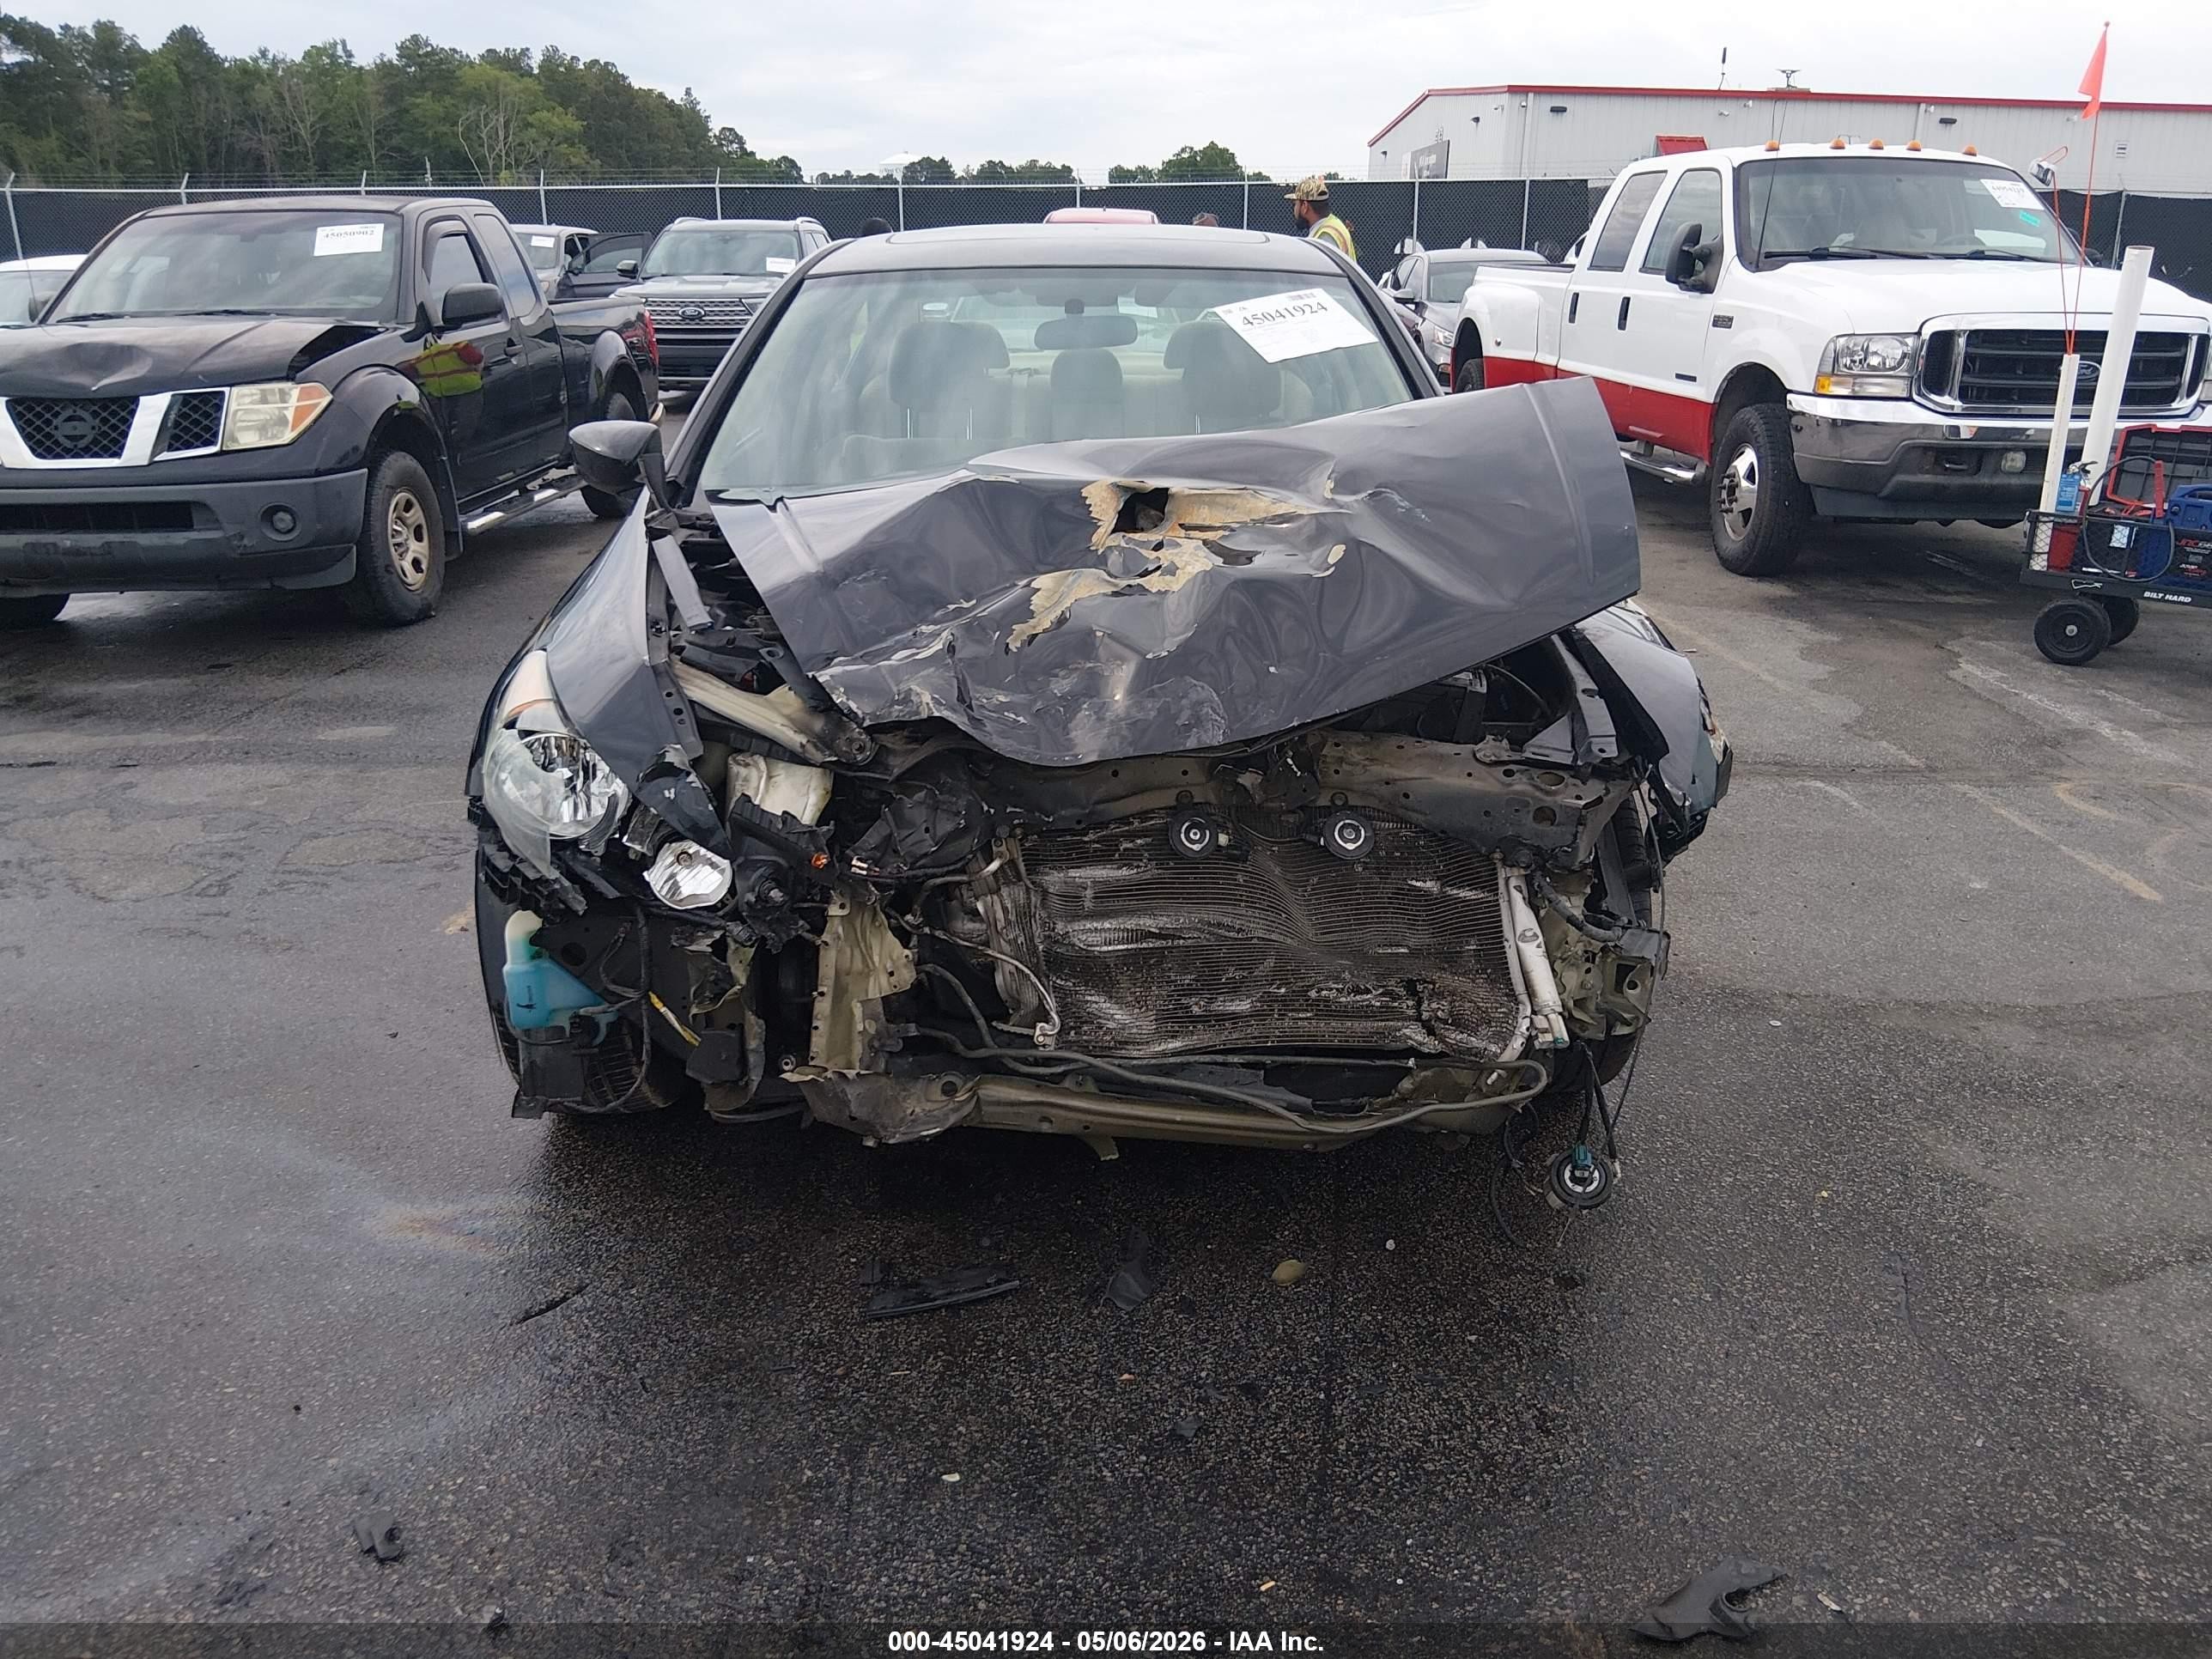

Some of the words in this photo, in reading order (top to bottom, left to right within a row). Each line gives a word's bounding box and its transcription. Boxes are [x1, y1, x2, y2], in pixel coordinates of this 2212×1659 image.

[1243, 301, 1328, 326] 45041924
[2143, 591, 2165, 599] BILT
[2165, 594, 2191, 603] HARD
